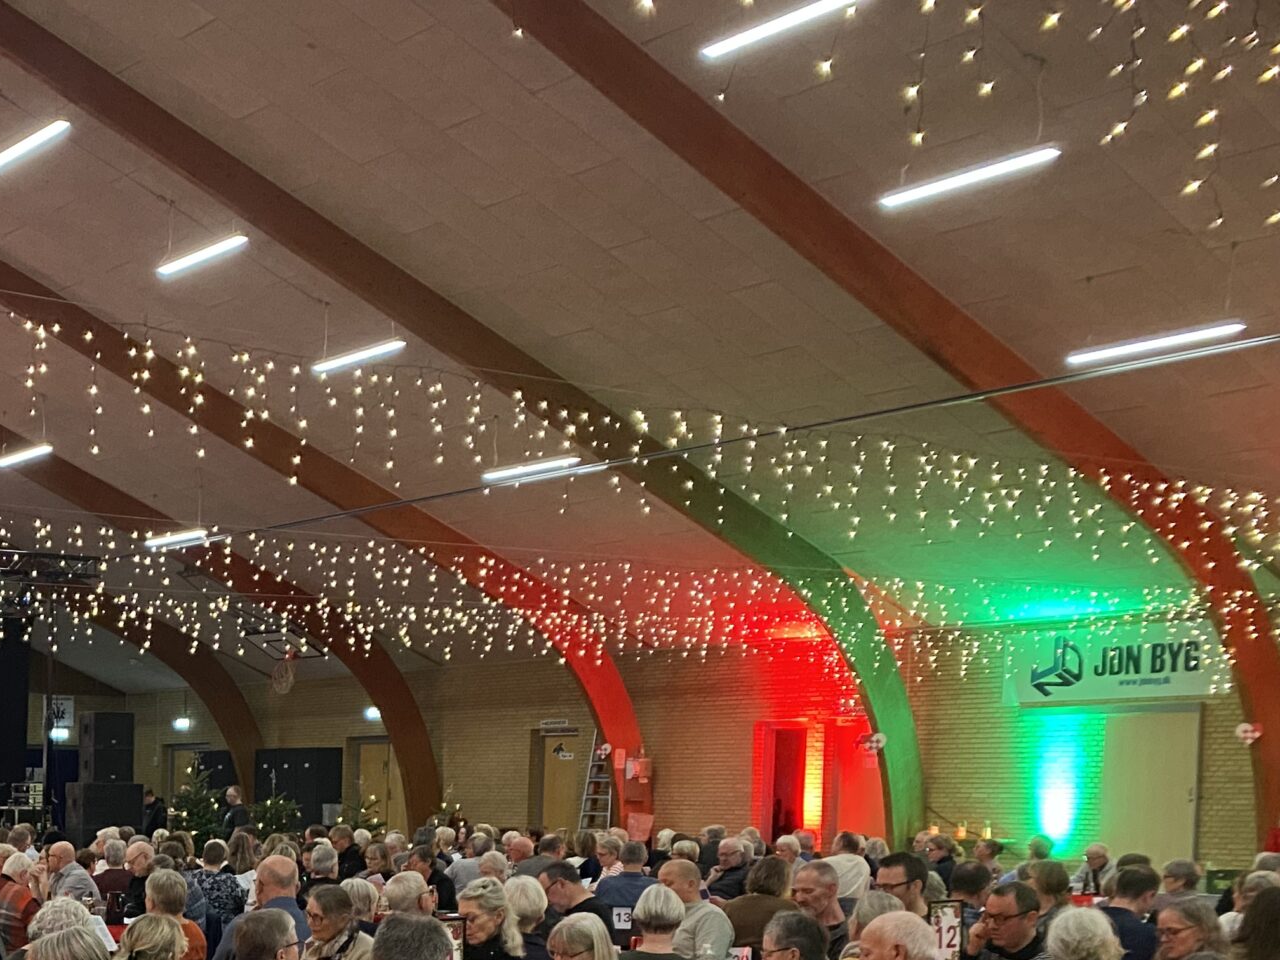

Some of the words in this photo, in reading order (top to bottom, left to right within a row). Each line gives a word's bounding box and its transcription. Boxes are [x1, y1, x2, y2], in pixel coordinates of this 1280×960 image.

[1094, 645, 1142, 676] JDN
[1150, 641, 1200, 673] BYG
[615, 912, 631, 923] 13
[936, 925, 957, 949] 12
